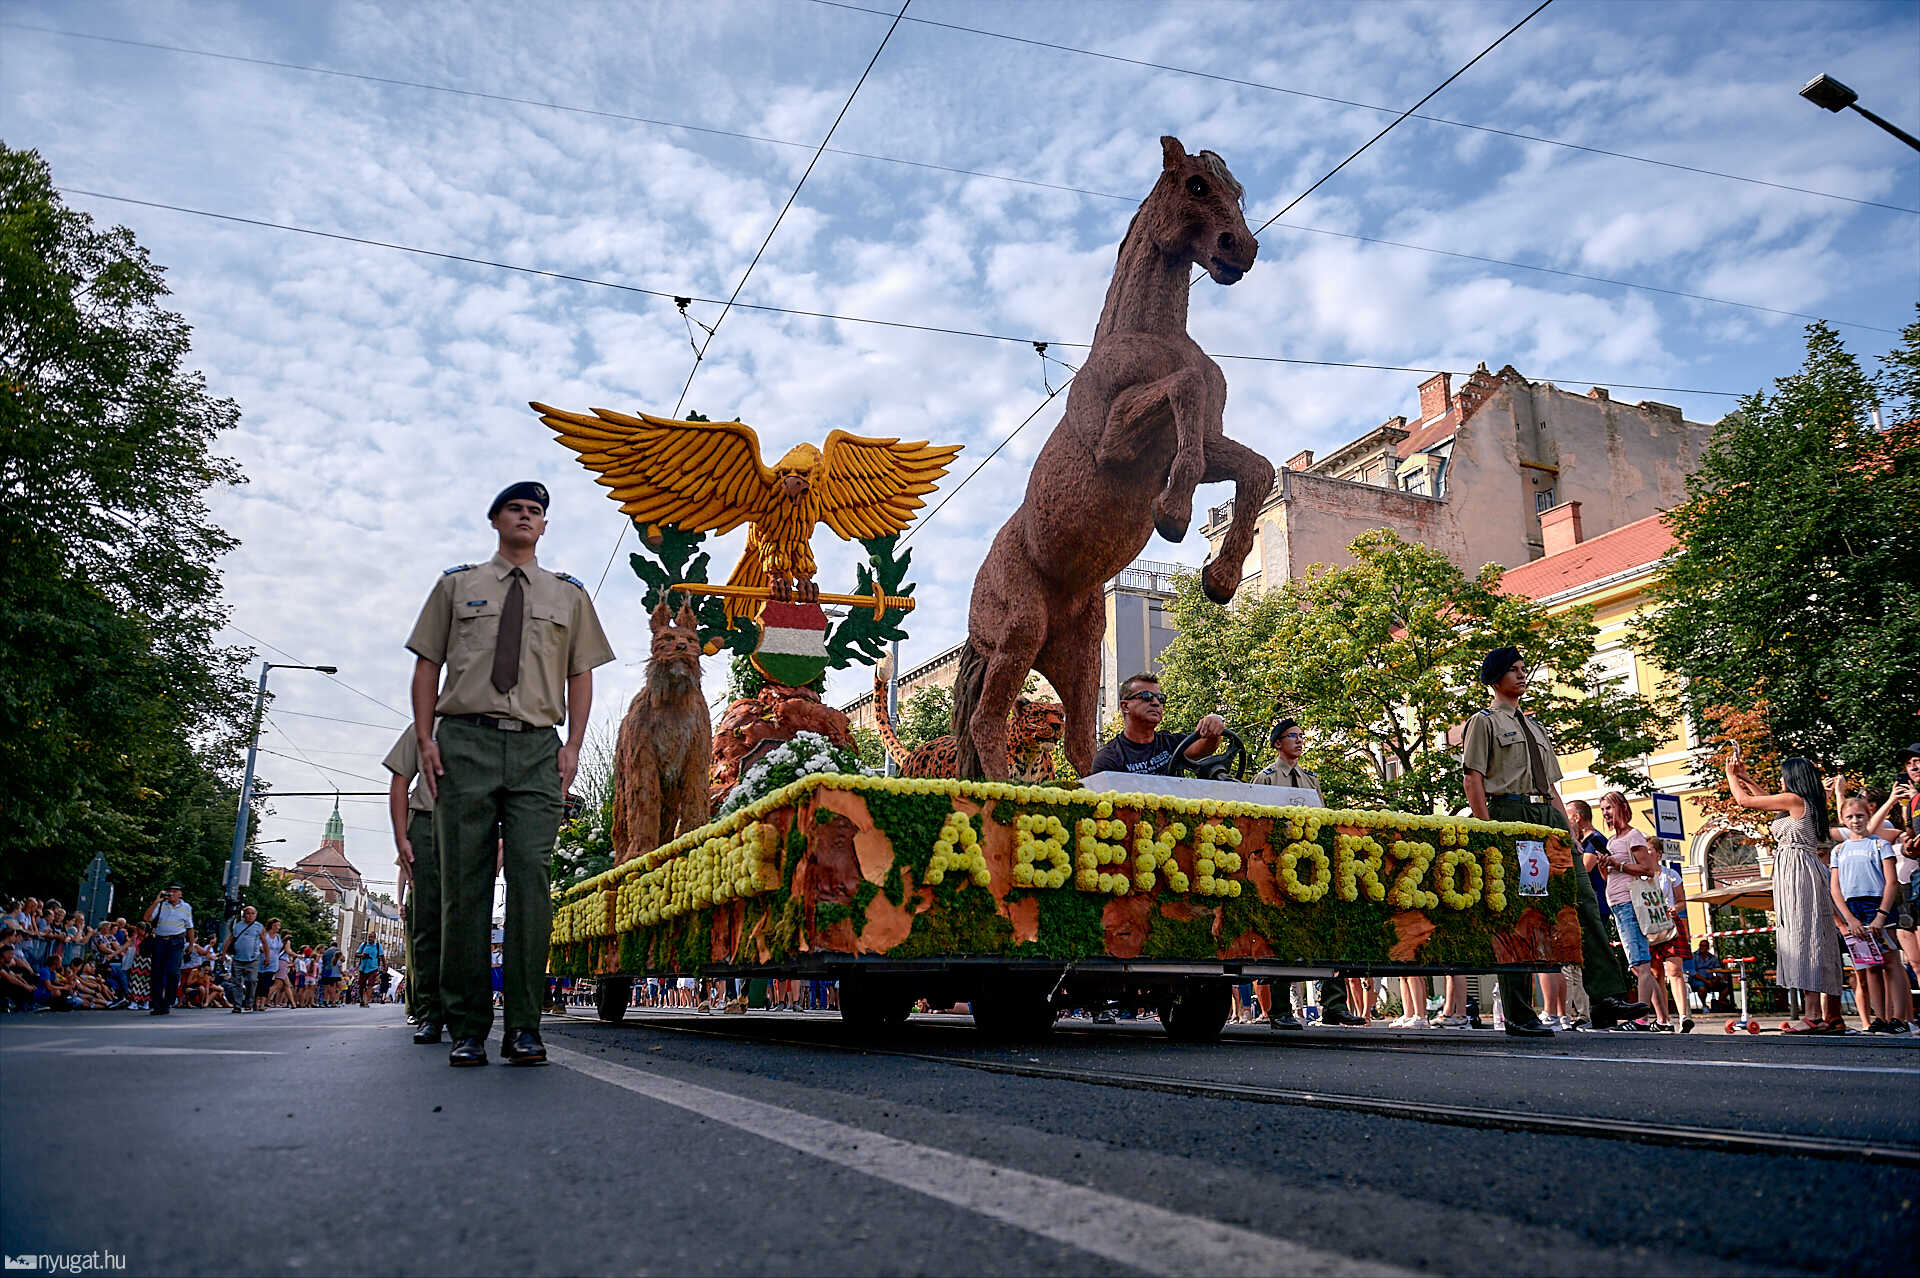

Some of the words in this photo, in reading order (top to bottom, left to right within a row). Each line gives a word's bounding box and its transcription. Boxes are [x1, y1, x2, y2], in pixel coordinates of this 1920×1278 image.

[1126, 761, 1148, 772] WHY
[923, 811, 991, 887] A
[1529, 858, 1539, 877] 3
